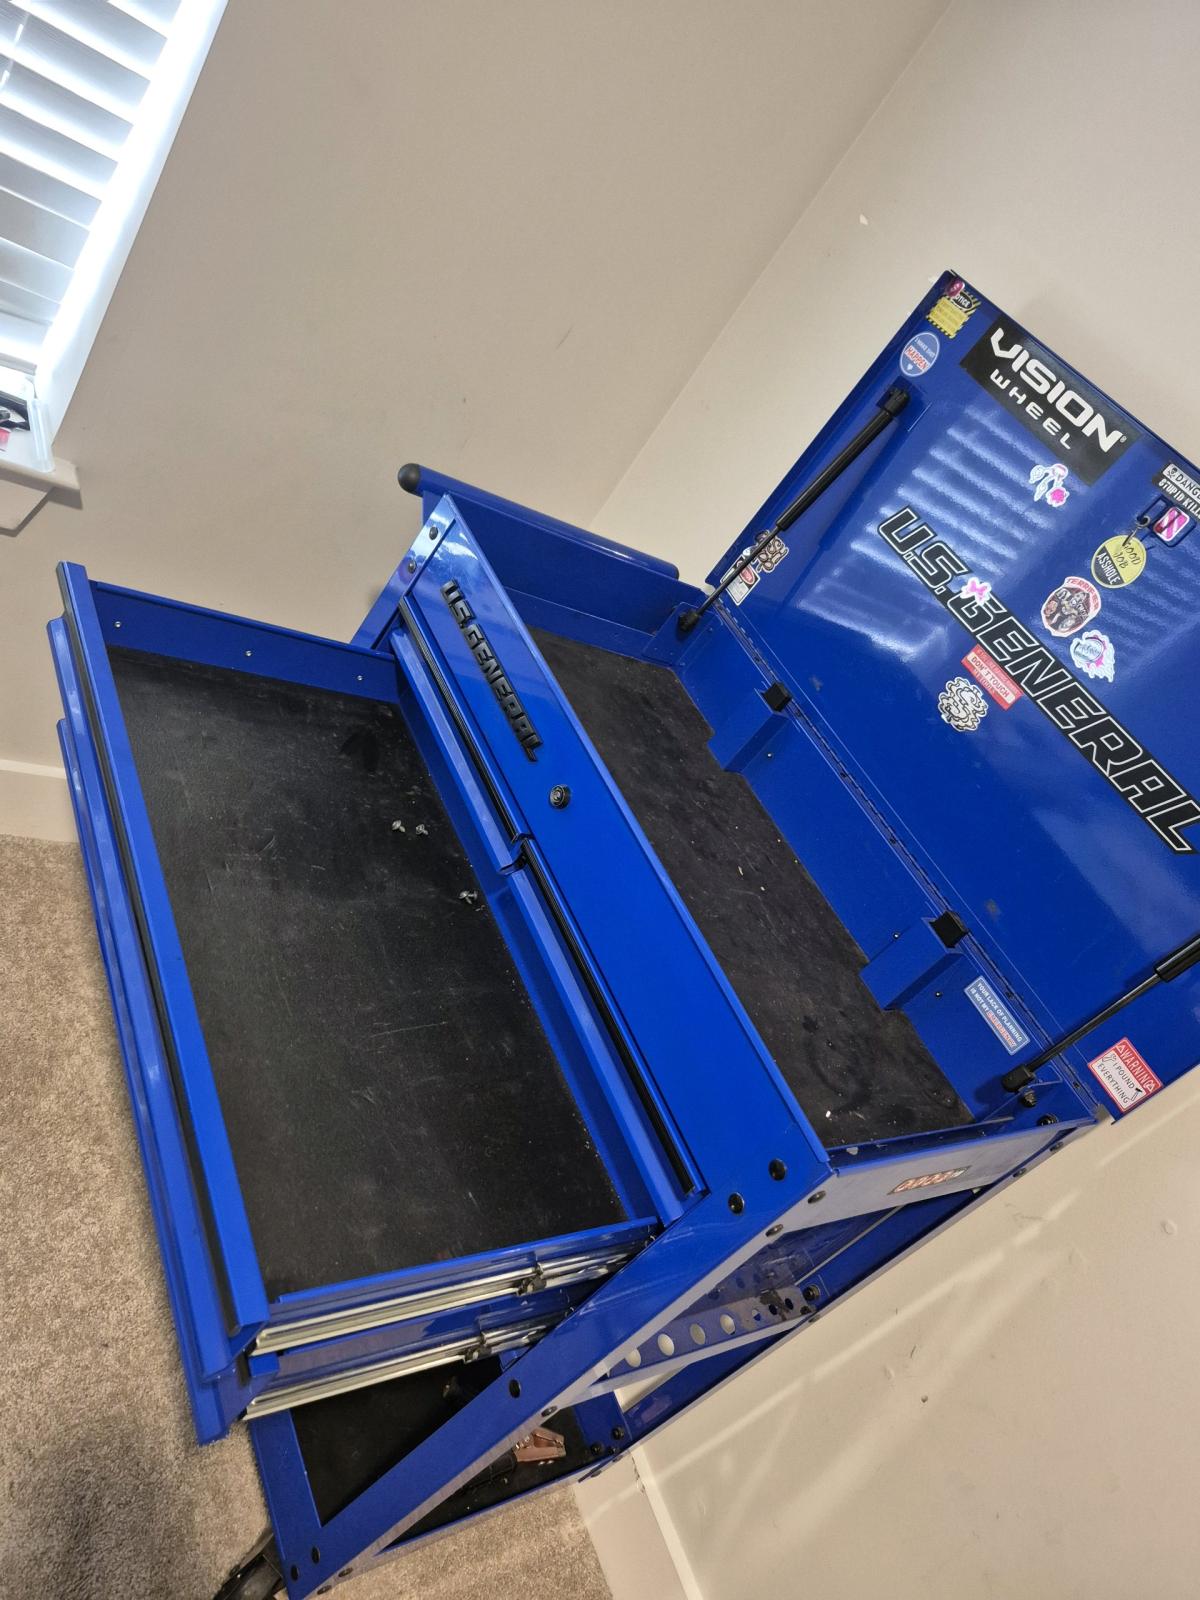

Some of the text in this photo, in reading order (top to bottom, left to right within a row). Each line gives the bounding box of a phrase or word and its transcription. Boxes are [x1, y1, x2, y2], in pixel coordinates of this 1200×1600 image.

[990, 327, 1123, 453] VISION
[990, 369, 1071, 449] WHEEL
[1157, 476, 1186, 503] STUPID
[1095, 550, 1121, 585] ASSHOLE
[461, 621, 543, 762] GENERAL
[987, 674, 1010, 698] TOUCH
[947, 578, 1200, 851] GENERAL
[973, 992, 985, 1005] NOT
[976, 981, 990, 997] YOUR
[986, 995, 999, 1010] LACK
[1000, 1015, 1023, 1042] PLANNING
[1096, 1062, 1130, 1104] EVERYTHING
[1114, 1064, 1135, 1090] POUND
[1119, 1048, 1154, 1089] WARNING
